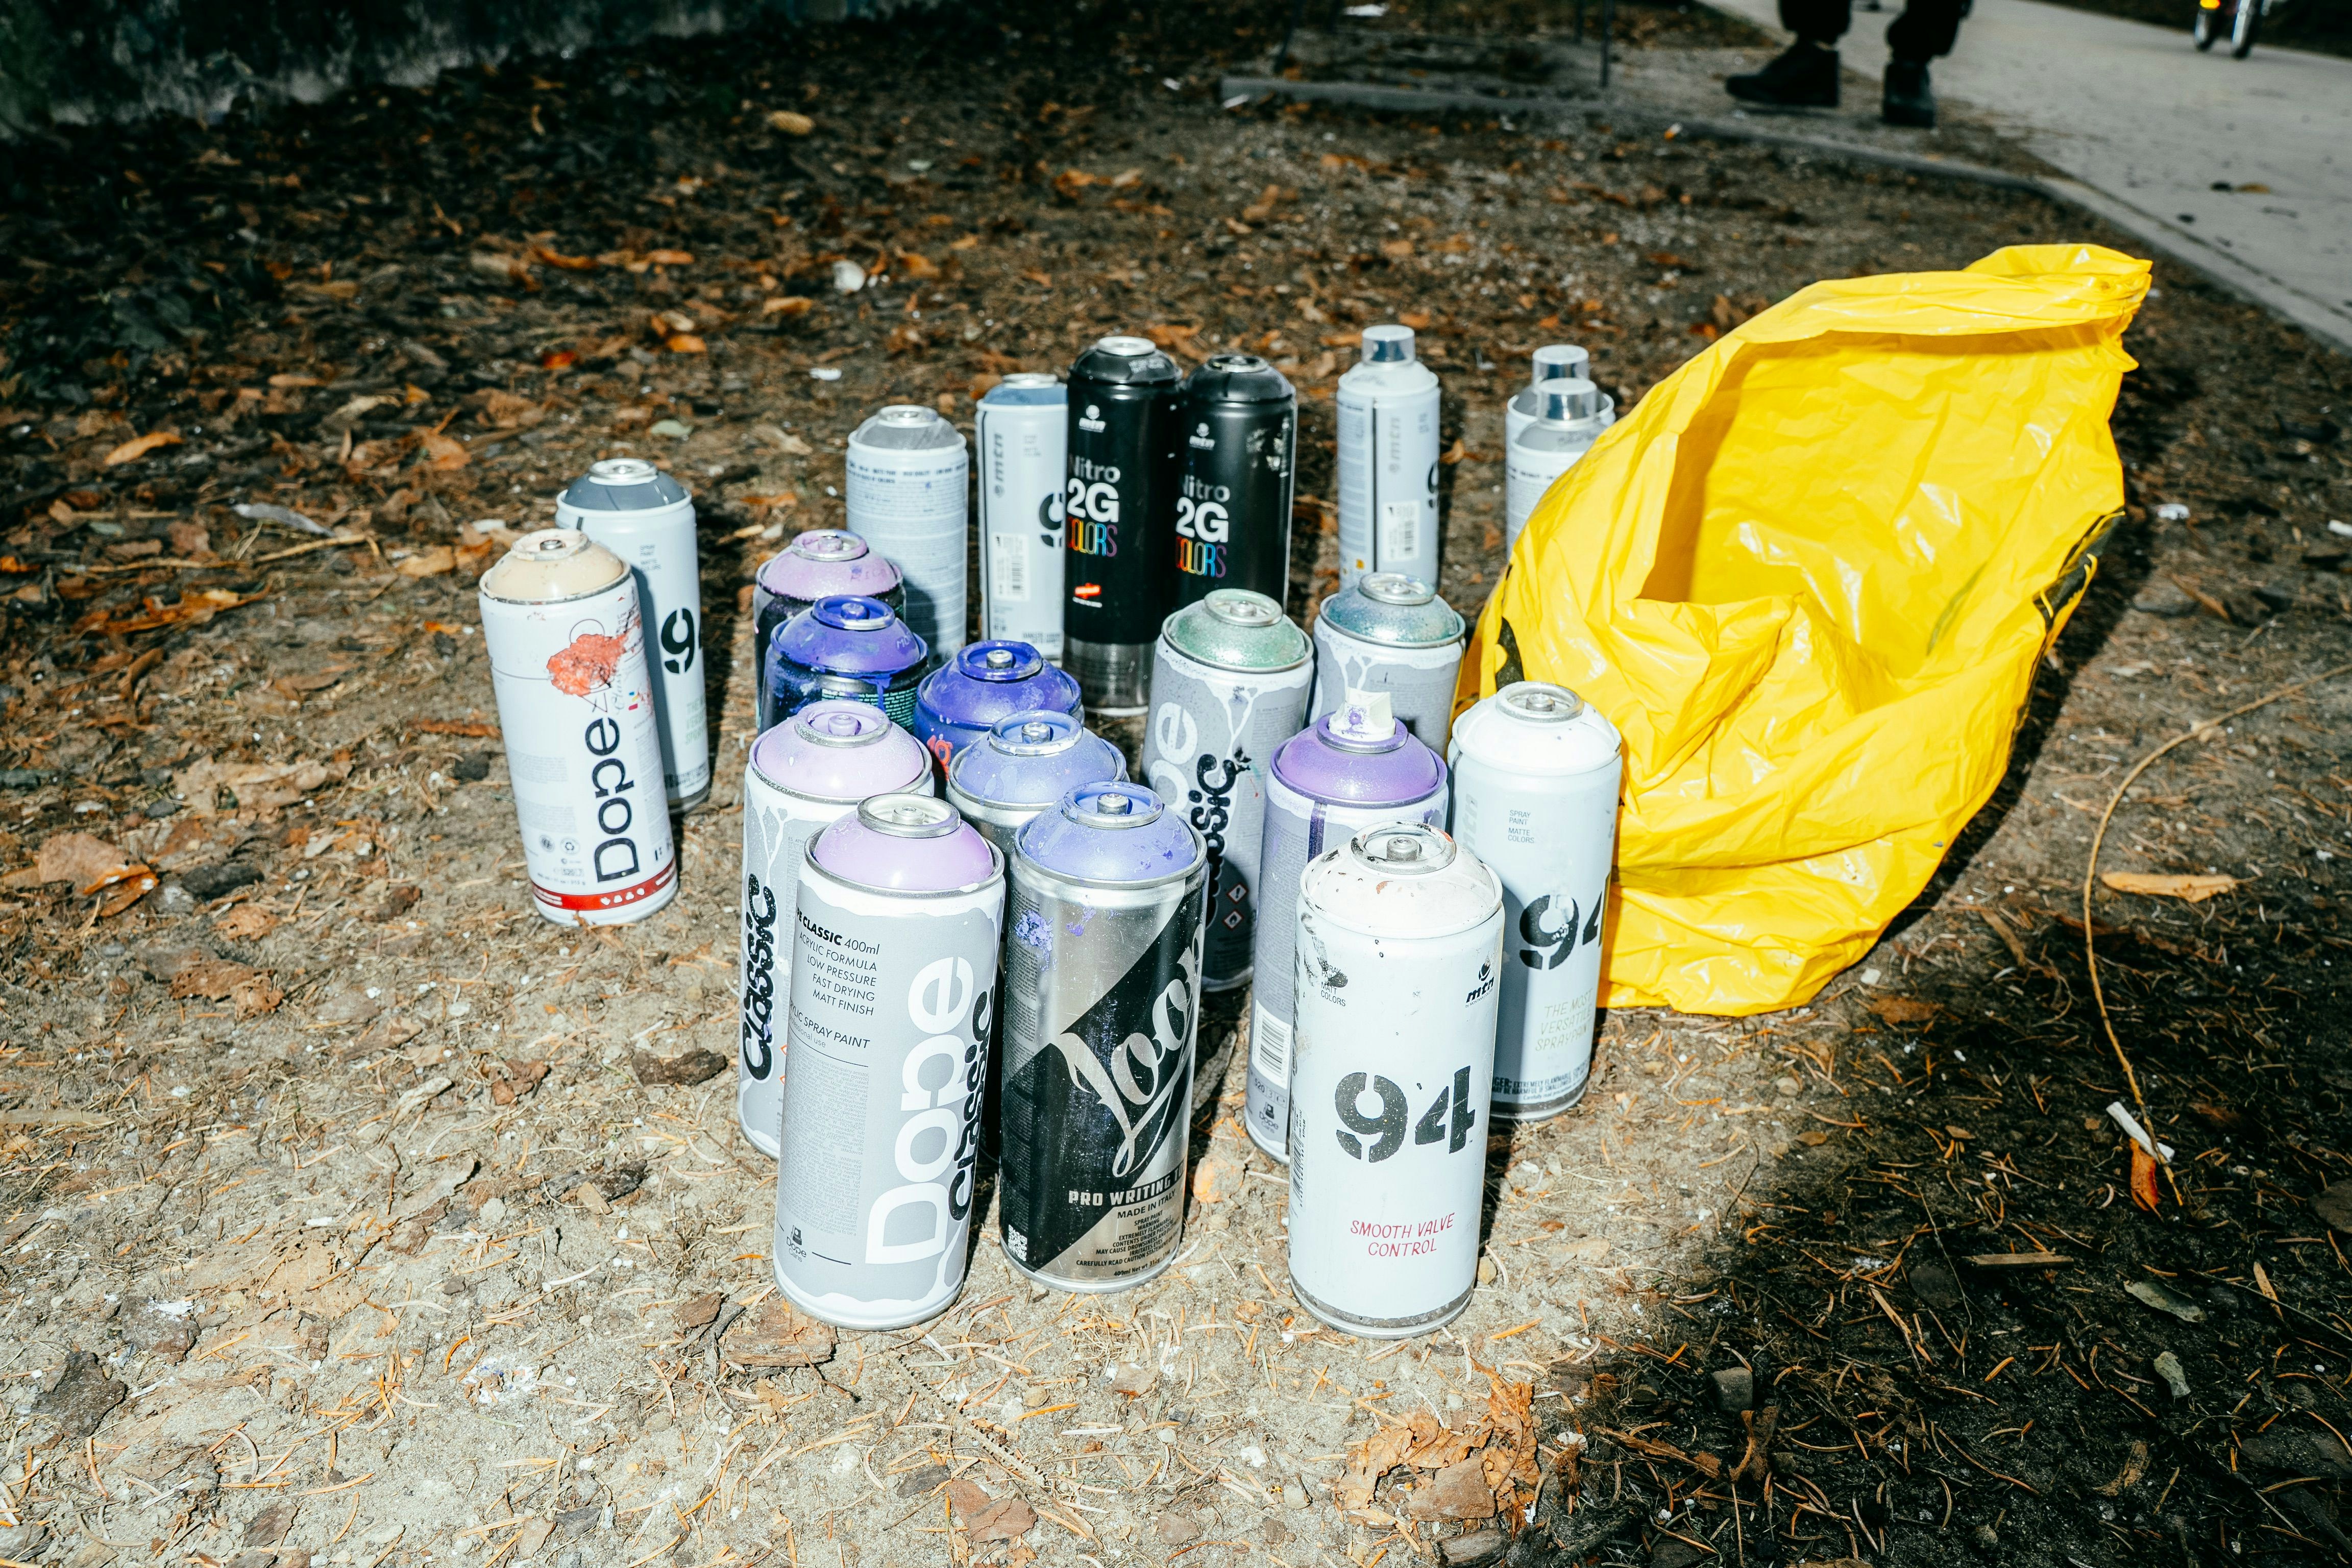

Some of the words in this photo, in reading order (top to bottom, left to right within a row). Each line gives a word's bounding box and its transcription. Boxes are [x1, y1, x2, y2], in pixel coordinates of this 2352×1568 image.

[1067, 478, 1119, 522] 2G
[1175, 497, 1229, 543] 2G
[660, 608, 702, 675] 9
[585, 716, 641, 883] Dope
[1508, 827, 1530, 836] MATTE
[1509, 817, 1528, 825] PAINT
[1507, 835, 1535, 843] COLORS
[803, 916, 843, 946] CLASSIC
[844, 938, 880, 955] 400ml
[799, 931, 824, 955] ACRYLIC
[826, 949, 877, 971] FORMULA
[743, 873, 776, 1082] Classic
[807, 953, 825, 970] LOW
[827, 965, 877, 987] PRESSURE
[813, 973, 831, 989] FAST
[834, 983, 875, 1001] DRYING
[1321, 982, 1337, 994] MATT
[1321, 990, 1345, 1006] COLORS
[1466, 976, 1494, 1003] mtn
[813, 989, 836, 1006] MATT
[839, 999, 874, 1016] FINISH
[1545, 1002, 1568, 1018] THE
[1570, 988, 1592, 1011] MOST
[803, 1016, 832, 1038] SPRAY
[834, 1032, 870, 1048] PAINT
[1541, 1003, 1592, 1035] VERSATILE
[813, 1037, 826, 1048] use
[865, 956, 974, 1265] Dope
[948, 990, 995, 1221] Classic
[1335, 1066, 1476, 1163] 94
[1259, 1111, 1279, 1130] Dope
[1068, 1190, 1103, 1206] PRO
[1110, 1175, 1170, 1206] WRITING
[1117, 1205, 1145, 1218] MADE
[1148, 1201, 1157, 1212] IN
[1158, 1189, 1175, 1207] ITALY
[1119, 1229, 1147, 1241] EXTREMELY
[1148, 1215, 1172, 1232] FLAMMABLE
[1134, 1216, 1149, 1226] SPRAY
[1150, 1210, 1163, 1219] PAINT
[1137, 1217, 1160, 1231] WARNING
[1350, 1220, 1412, 1239] SMOOTH
[1417, 1213, 1455, 1237] VALVE
[787, 1236, 807, 1257] Dope
[1109, 1245, 1126, 1254] CAUSE
[1128, 1236, 1158, 1251] DROWSINESS
[1113, 1238, 1139, 1247] CONTENTS
[1140, 1232, 1156, 1241] UNDER
[1124, 1252, 1145, 1263] CAUTION
[1146, 1240, 1168, 1257] STATEMENT
[1130, 1243, 1153, 1256] IRRITATES
[1153, 1239, 1163, 1247] EYES
[1368, 1238, 1437, 1257] CONTROL
[789, 1248, 803, 1262] Cans
